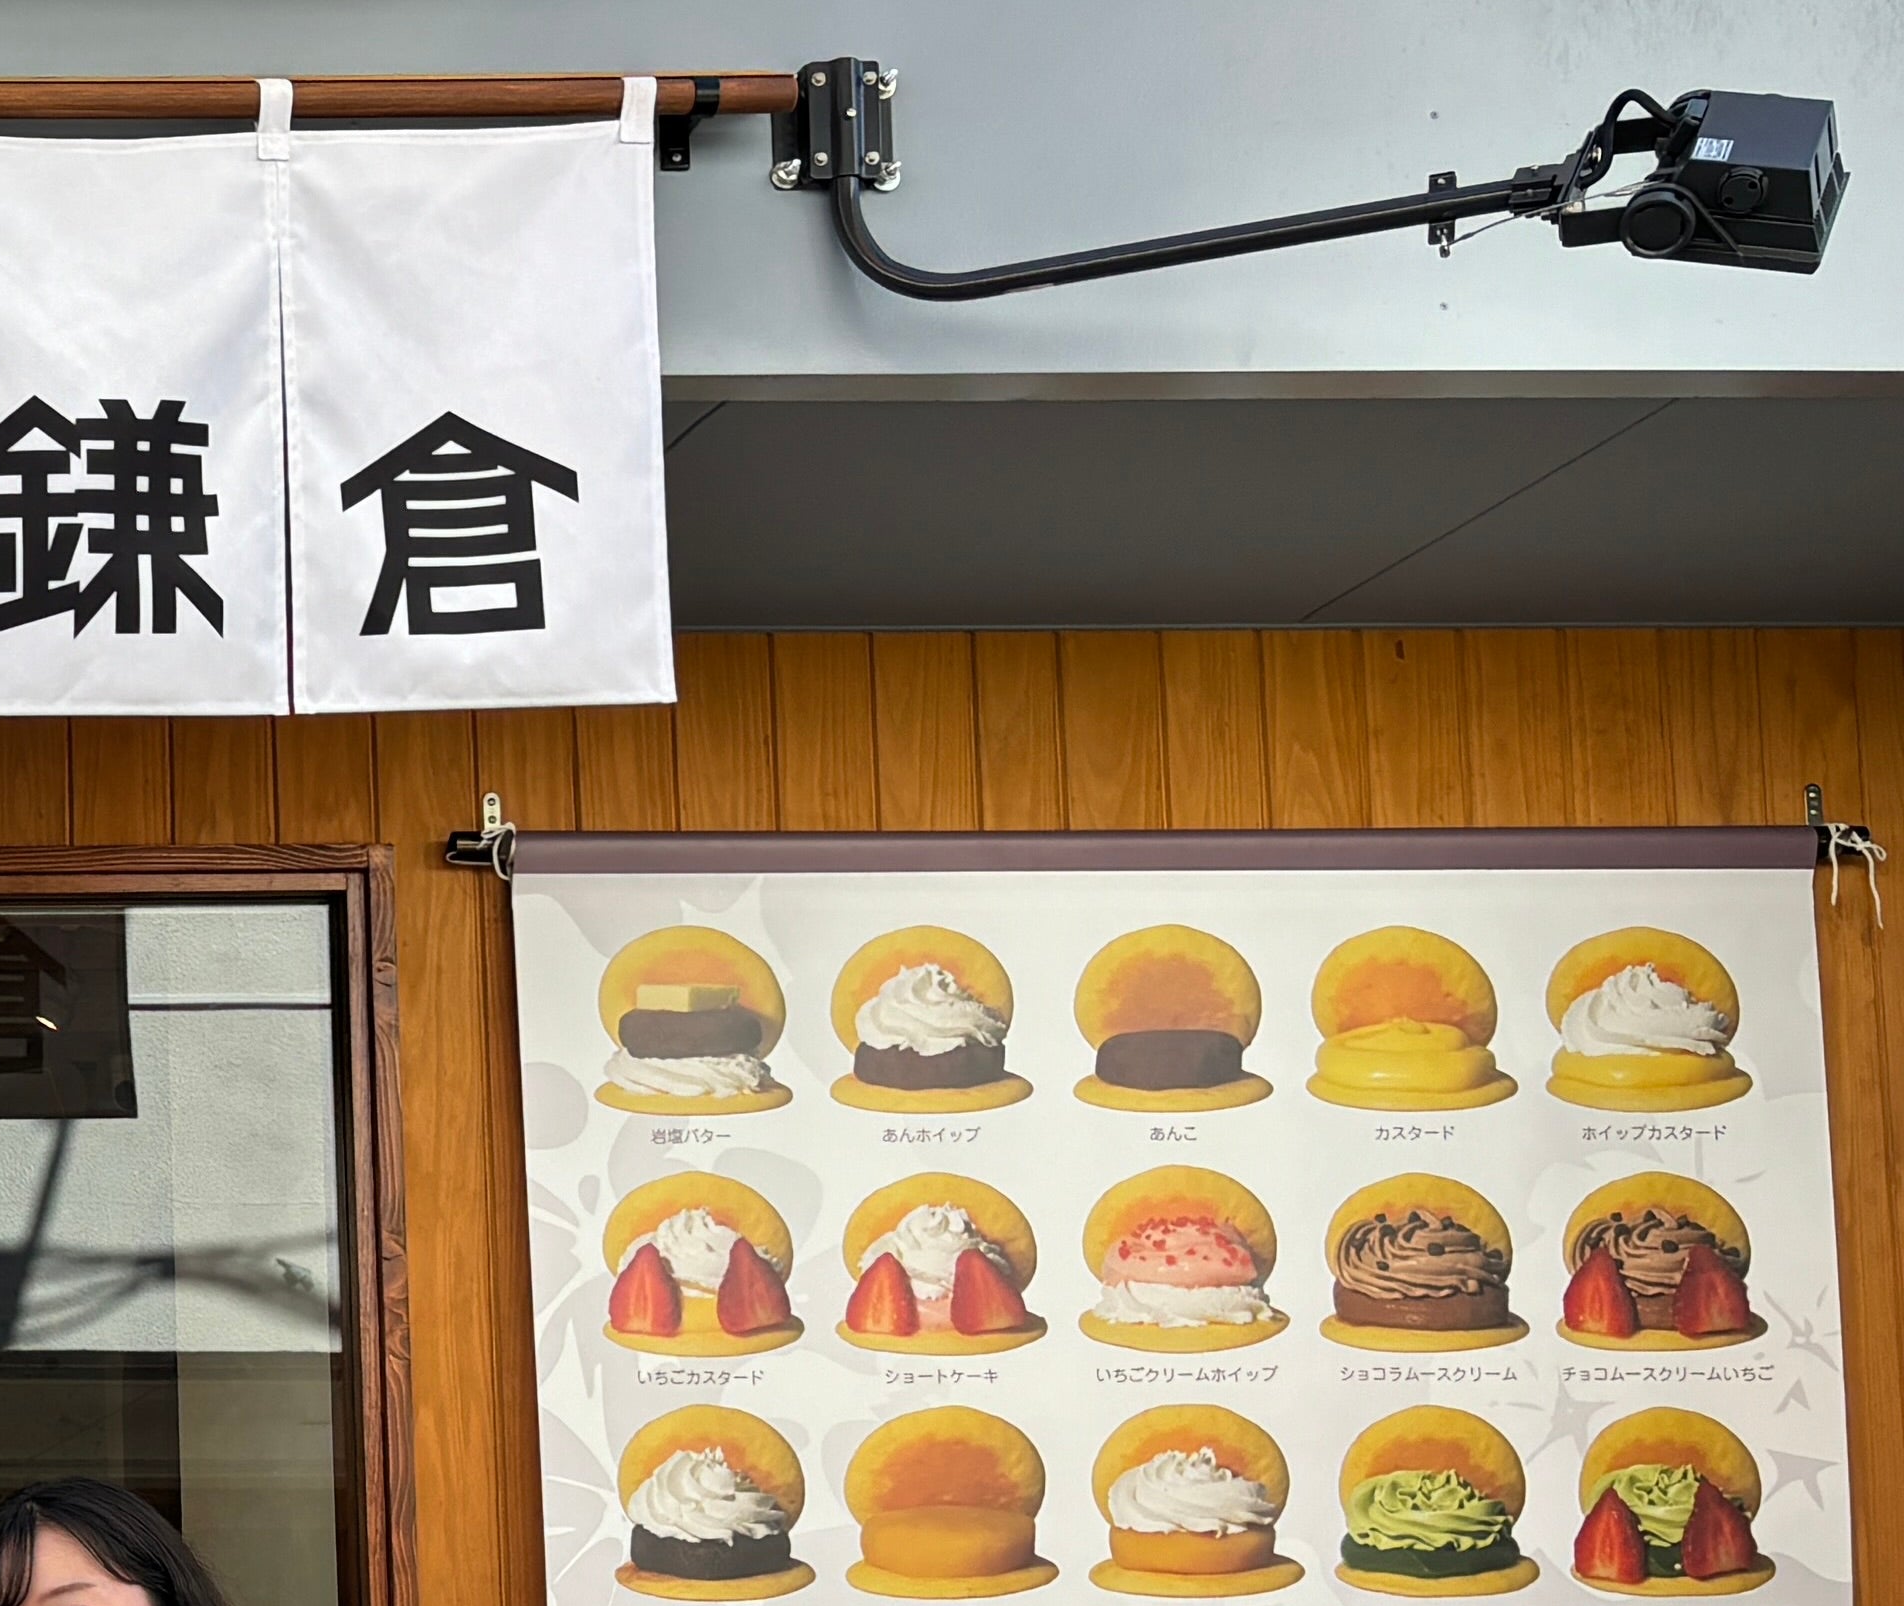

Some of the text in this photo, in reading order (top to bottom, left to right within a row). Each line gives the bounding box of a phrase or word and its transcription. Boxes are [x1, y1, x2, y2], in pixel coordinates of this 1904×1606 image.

[651, 1127, 732, 1145] 岩塩バター
[882, 1126, 982, 1144] あんホイップ
[1149, 1125, 1198, 1142] あんこ
[1375, 1125, 1456, 1142] カスタード
[1581, 1123, 1727, 1142] ホイップカスタード
[637, 1369, 765, 1386] いちごカスタード
[885, 1368, 999, 1385] ショートケーキ
[1096, 1365, 1279, 1384] いちごクリームホイップ
[1340, 1366, 1518, 1383] ショコラムースクリーム
[1562, 1364, 1775, 1383] チョコムースクリームいちご
